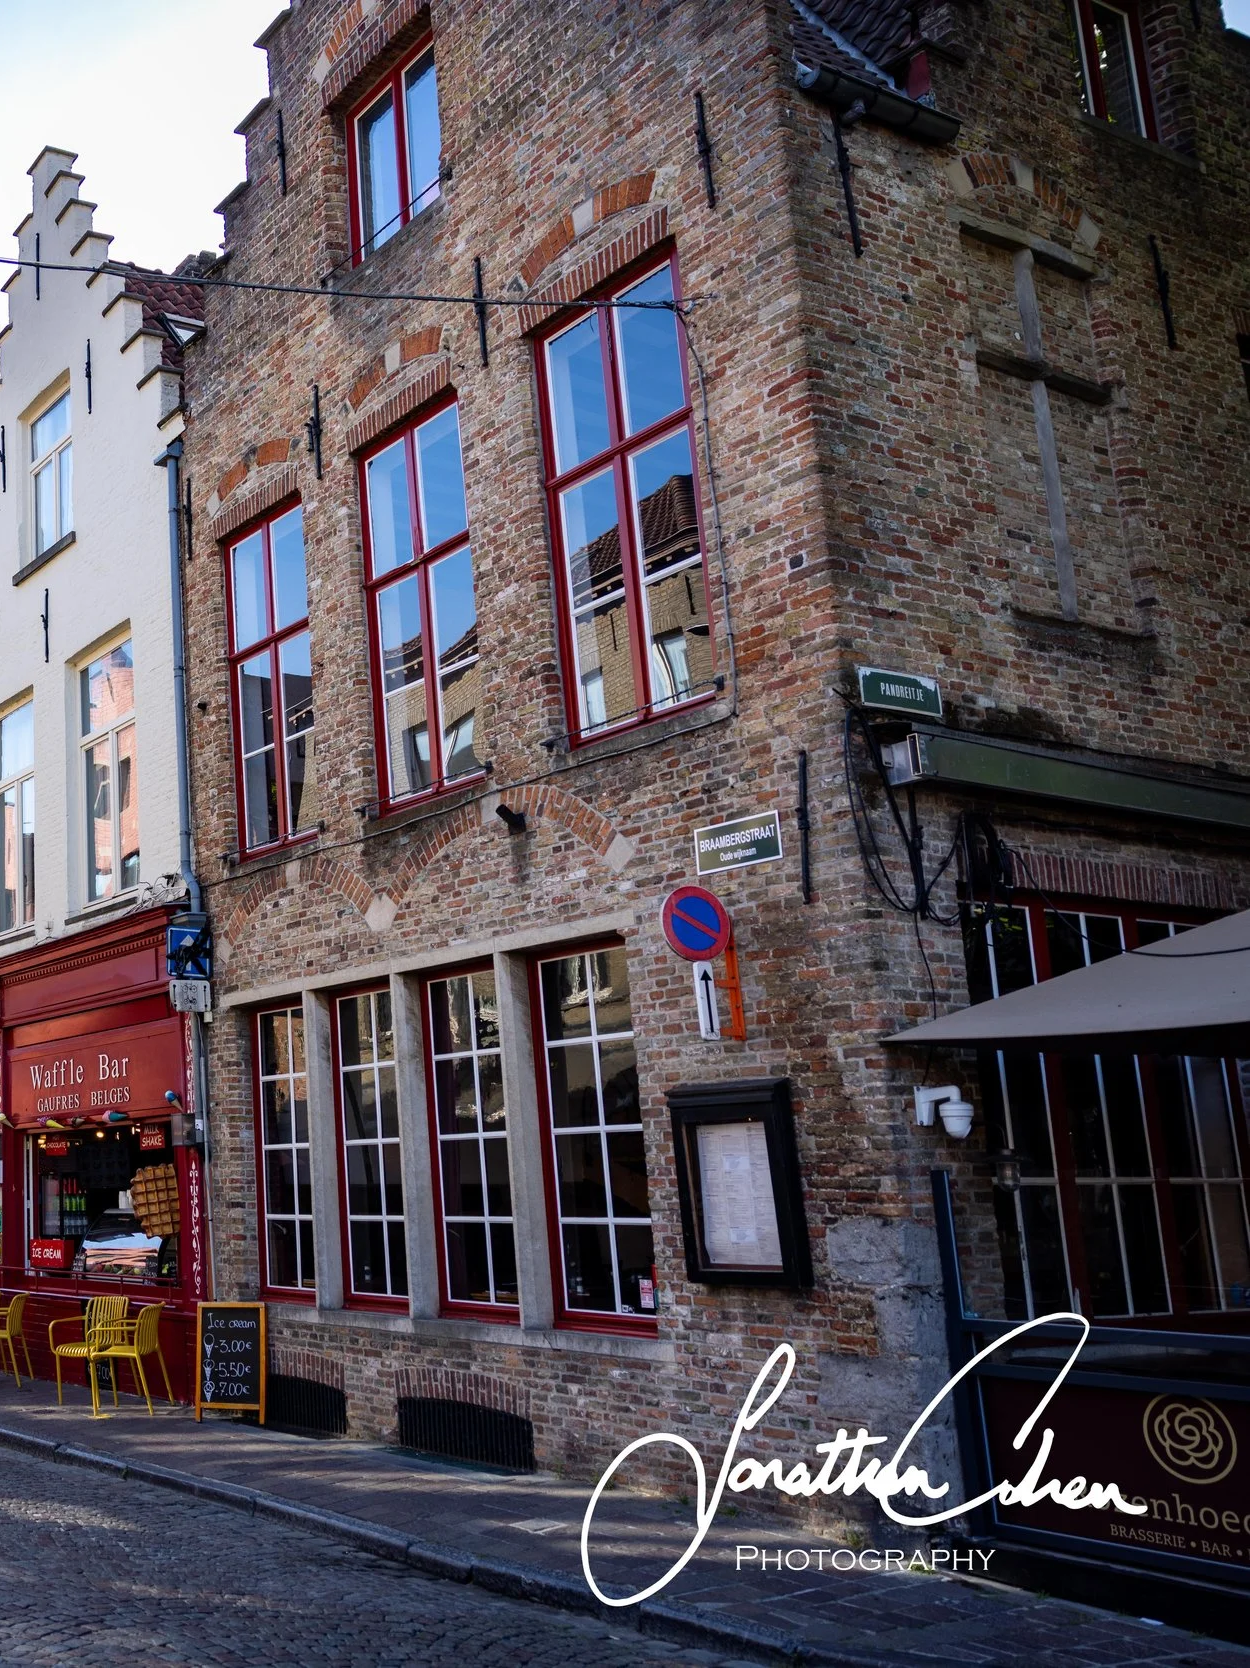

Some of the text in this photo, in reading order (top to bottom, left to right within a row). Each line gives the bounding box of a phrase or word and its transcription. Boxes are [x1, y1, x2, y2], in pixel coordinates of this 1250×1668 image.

[880, 682, 924, 702] PANDREITJE
[699, 824, 775, 853] BRAAMBERGSTRAAT
[719, 847, 757, 861] Oude wijknaam
[30, 1053, 129, 1090] Waffle Bar
[37, 1086, 130, 1112] GAUFRES BELGES
[143, 1125, 159, 1135] MILK
[142, 1135, 163, 1147] SHAKE
[32, 1247, 62, 1260] ICE CREAM
[207, 1312, 256, 1329] Ice cream
[1110, 1523, 1186, 1549] BRASSERIE
[1201, 1540, 1232, 1557] BAR
